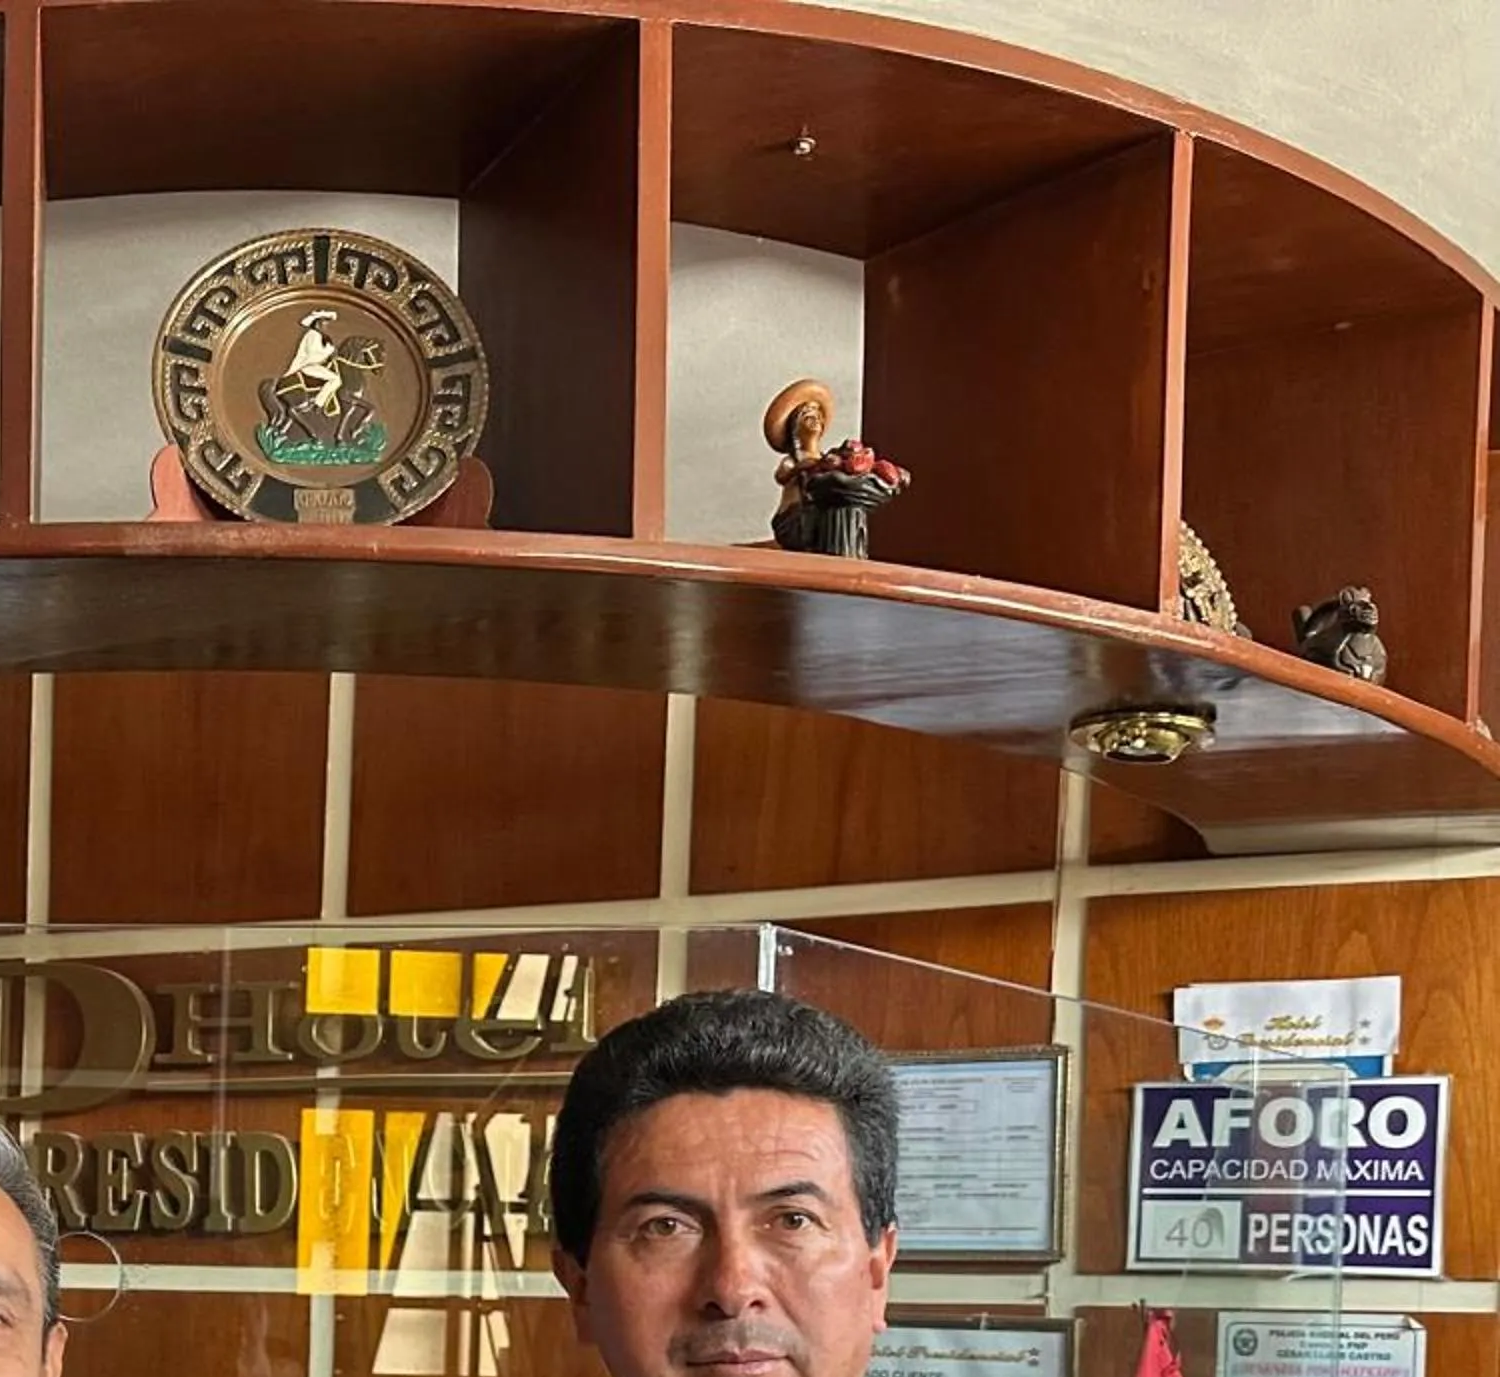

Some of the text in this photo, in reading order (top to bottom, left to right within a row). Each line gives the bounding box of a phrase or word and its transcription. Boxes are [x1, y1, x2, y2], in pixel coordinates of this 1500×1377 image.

[1152, 1095, 1428, 1149] AFORO
[1149, 1158, 1308, 1181] CAPACIDAD
[1165, 1213, 1429, 1257] 40 PERSONAS
[1347, 1342, 1368, 1351] PNP
